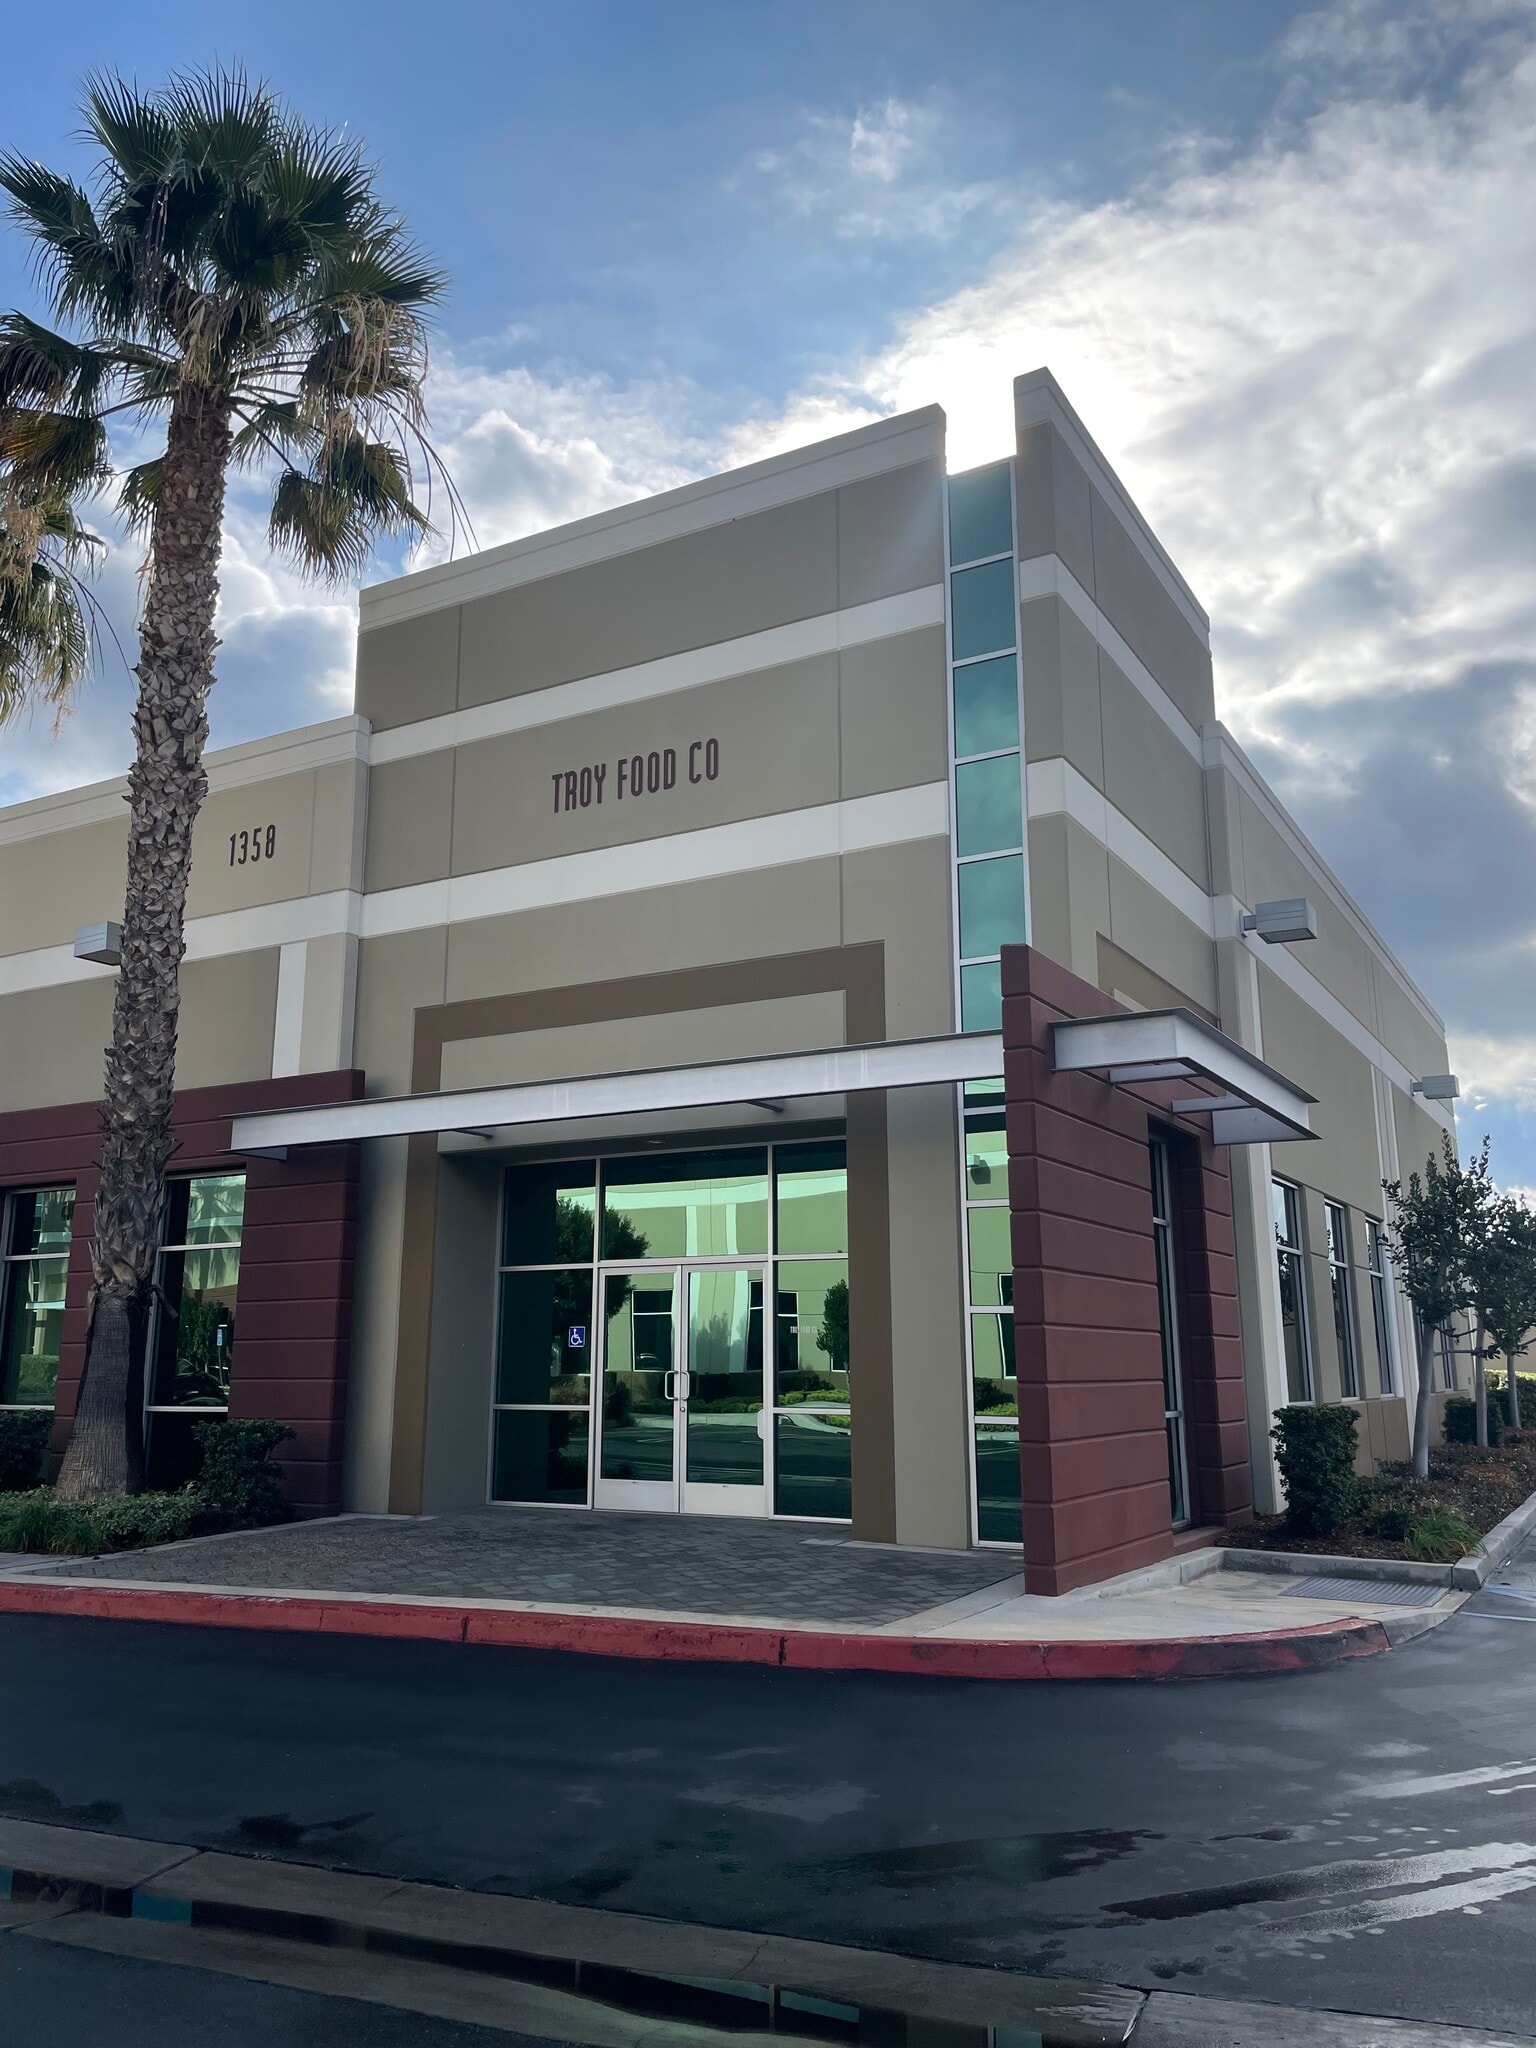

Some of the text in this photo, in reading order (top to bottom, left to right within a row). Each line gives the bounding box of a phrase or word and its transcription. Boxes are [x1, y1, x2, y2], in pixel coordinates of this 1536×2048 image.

[552, 738, 719, 813] TROY FOOD CO
[229, 824, 276, 867] 1358
